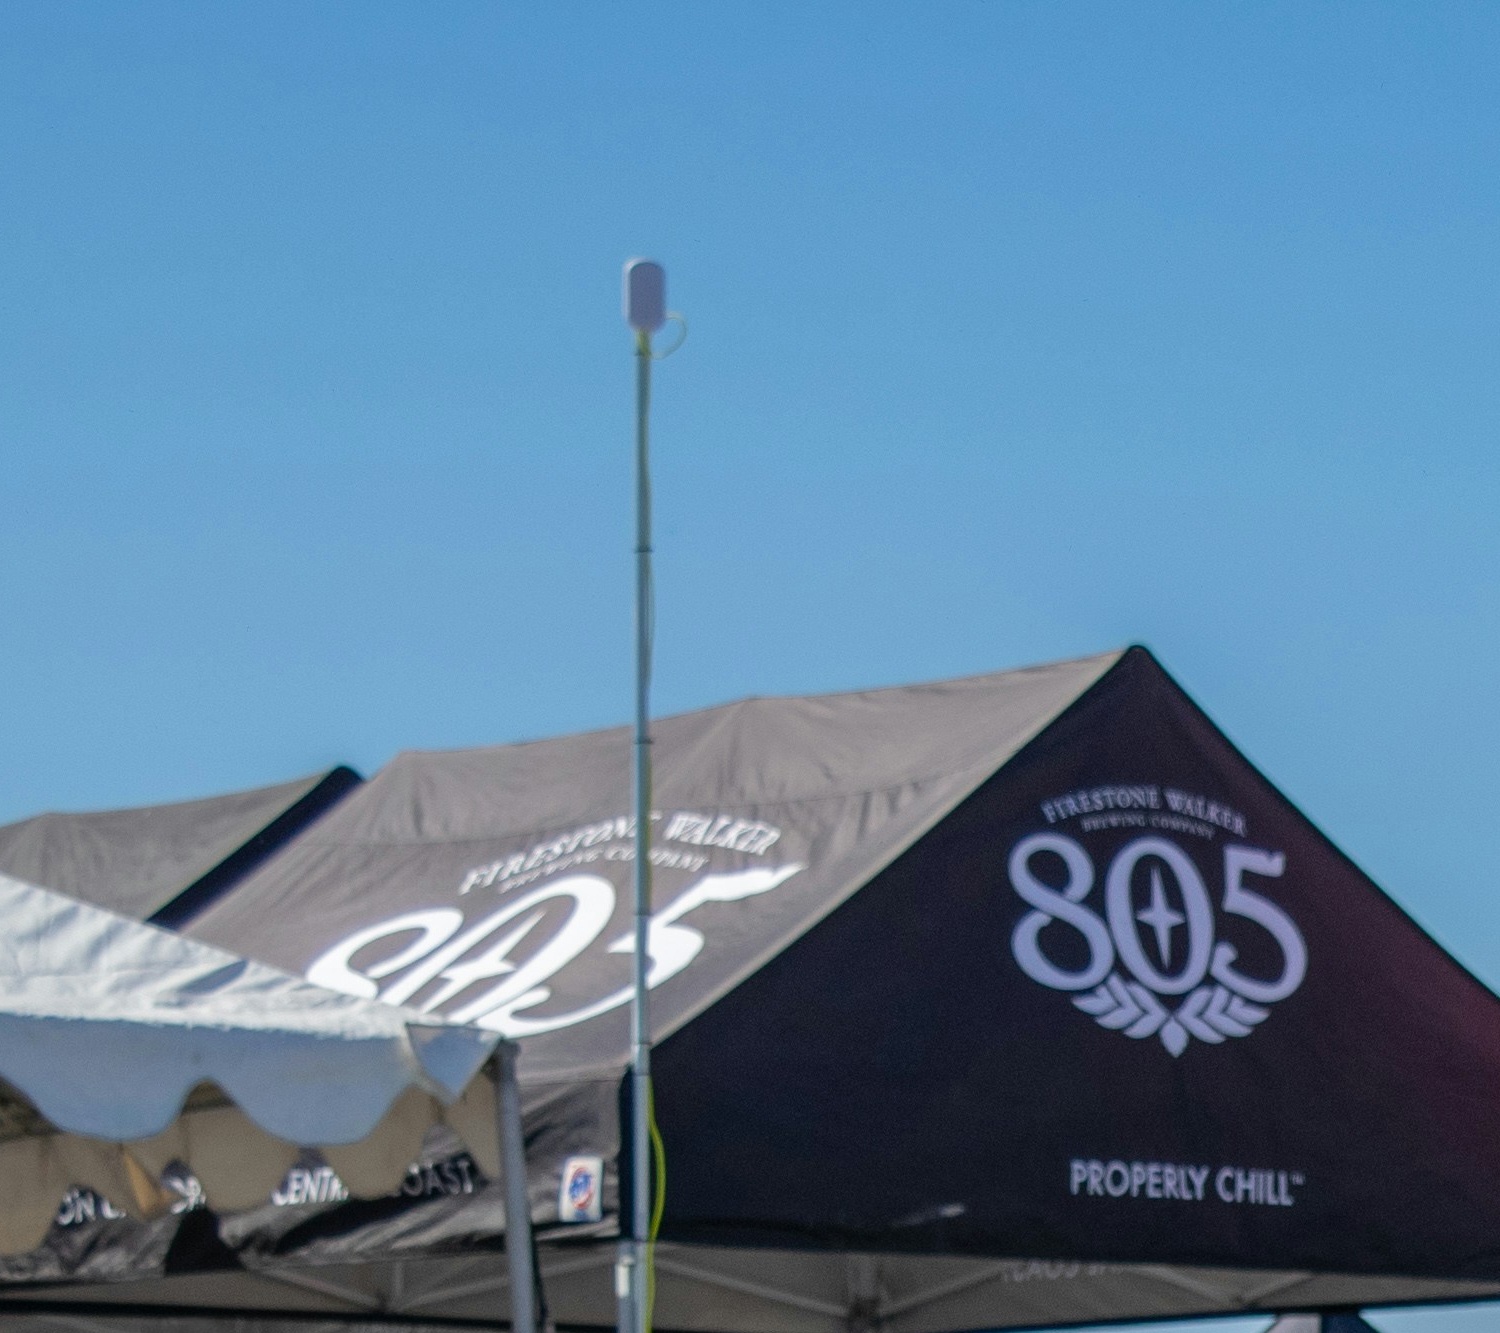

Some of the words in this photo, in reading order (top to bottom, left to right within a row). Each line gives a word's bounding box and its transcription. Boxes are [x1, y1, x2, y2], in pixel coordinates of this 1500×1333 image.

[1040, 784, 1161, 823] FIRESTONE
[1163, 786, 1248, 837] WALKER
[460, 813, 663, 895] FIRESTON
[664, 812, 782, 856] WALKER
[306, 864, 807, 1039] 805
[1008, 831, 1309, 1003] 805
[1070, 1159, 1210, 1200] PROPERLY
